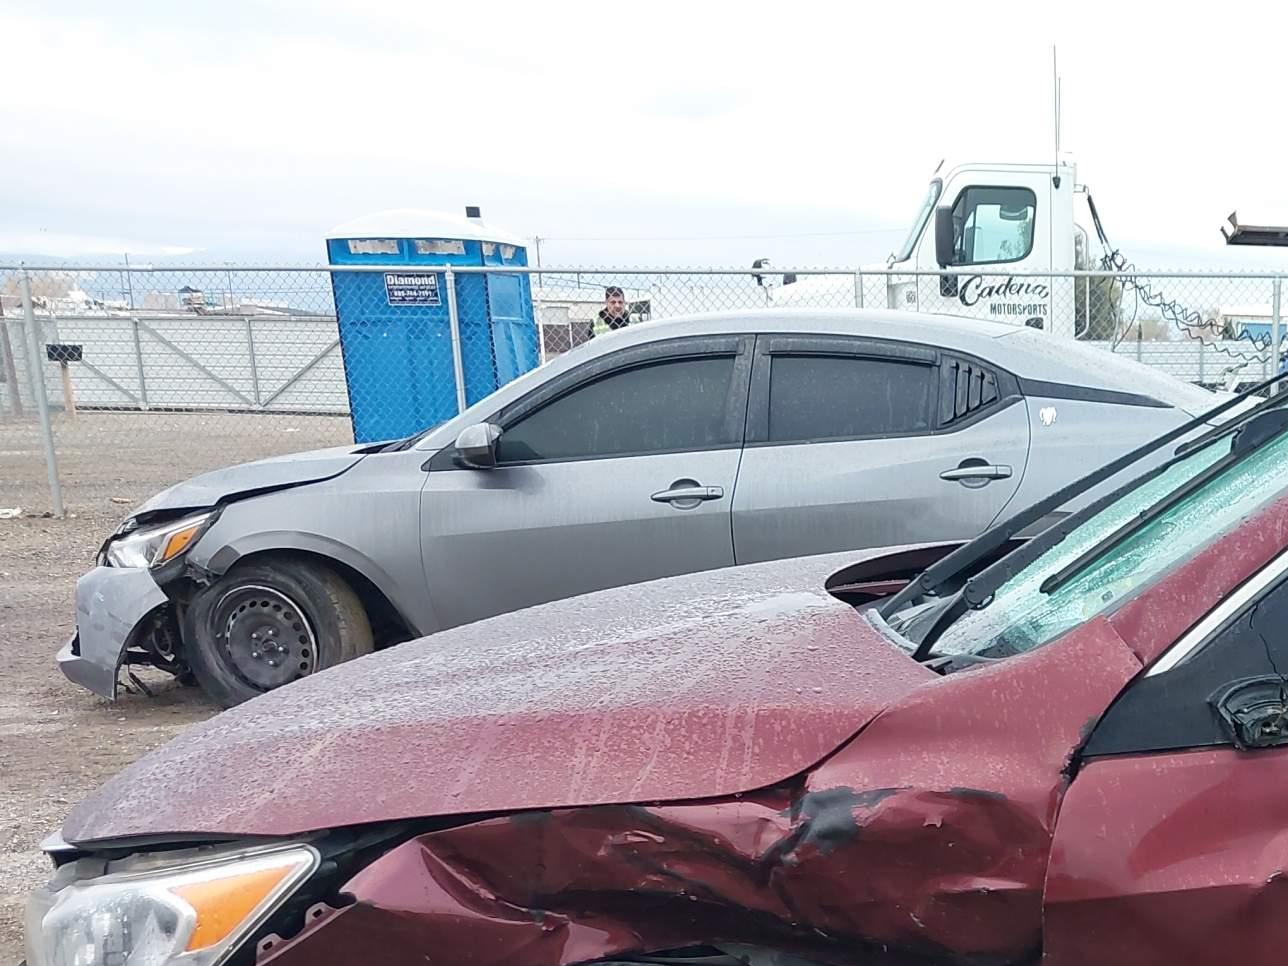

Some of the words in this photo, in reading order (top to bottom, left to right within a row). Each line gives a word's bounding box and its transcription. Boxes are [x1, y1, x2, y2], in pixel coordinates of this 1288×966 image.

[386, 275, 436, 285] Diamond
[959, 274, 1049, 307] Cadena
[990, 303, 1048, 316] MOTORSPORTS
